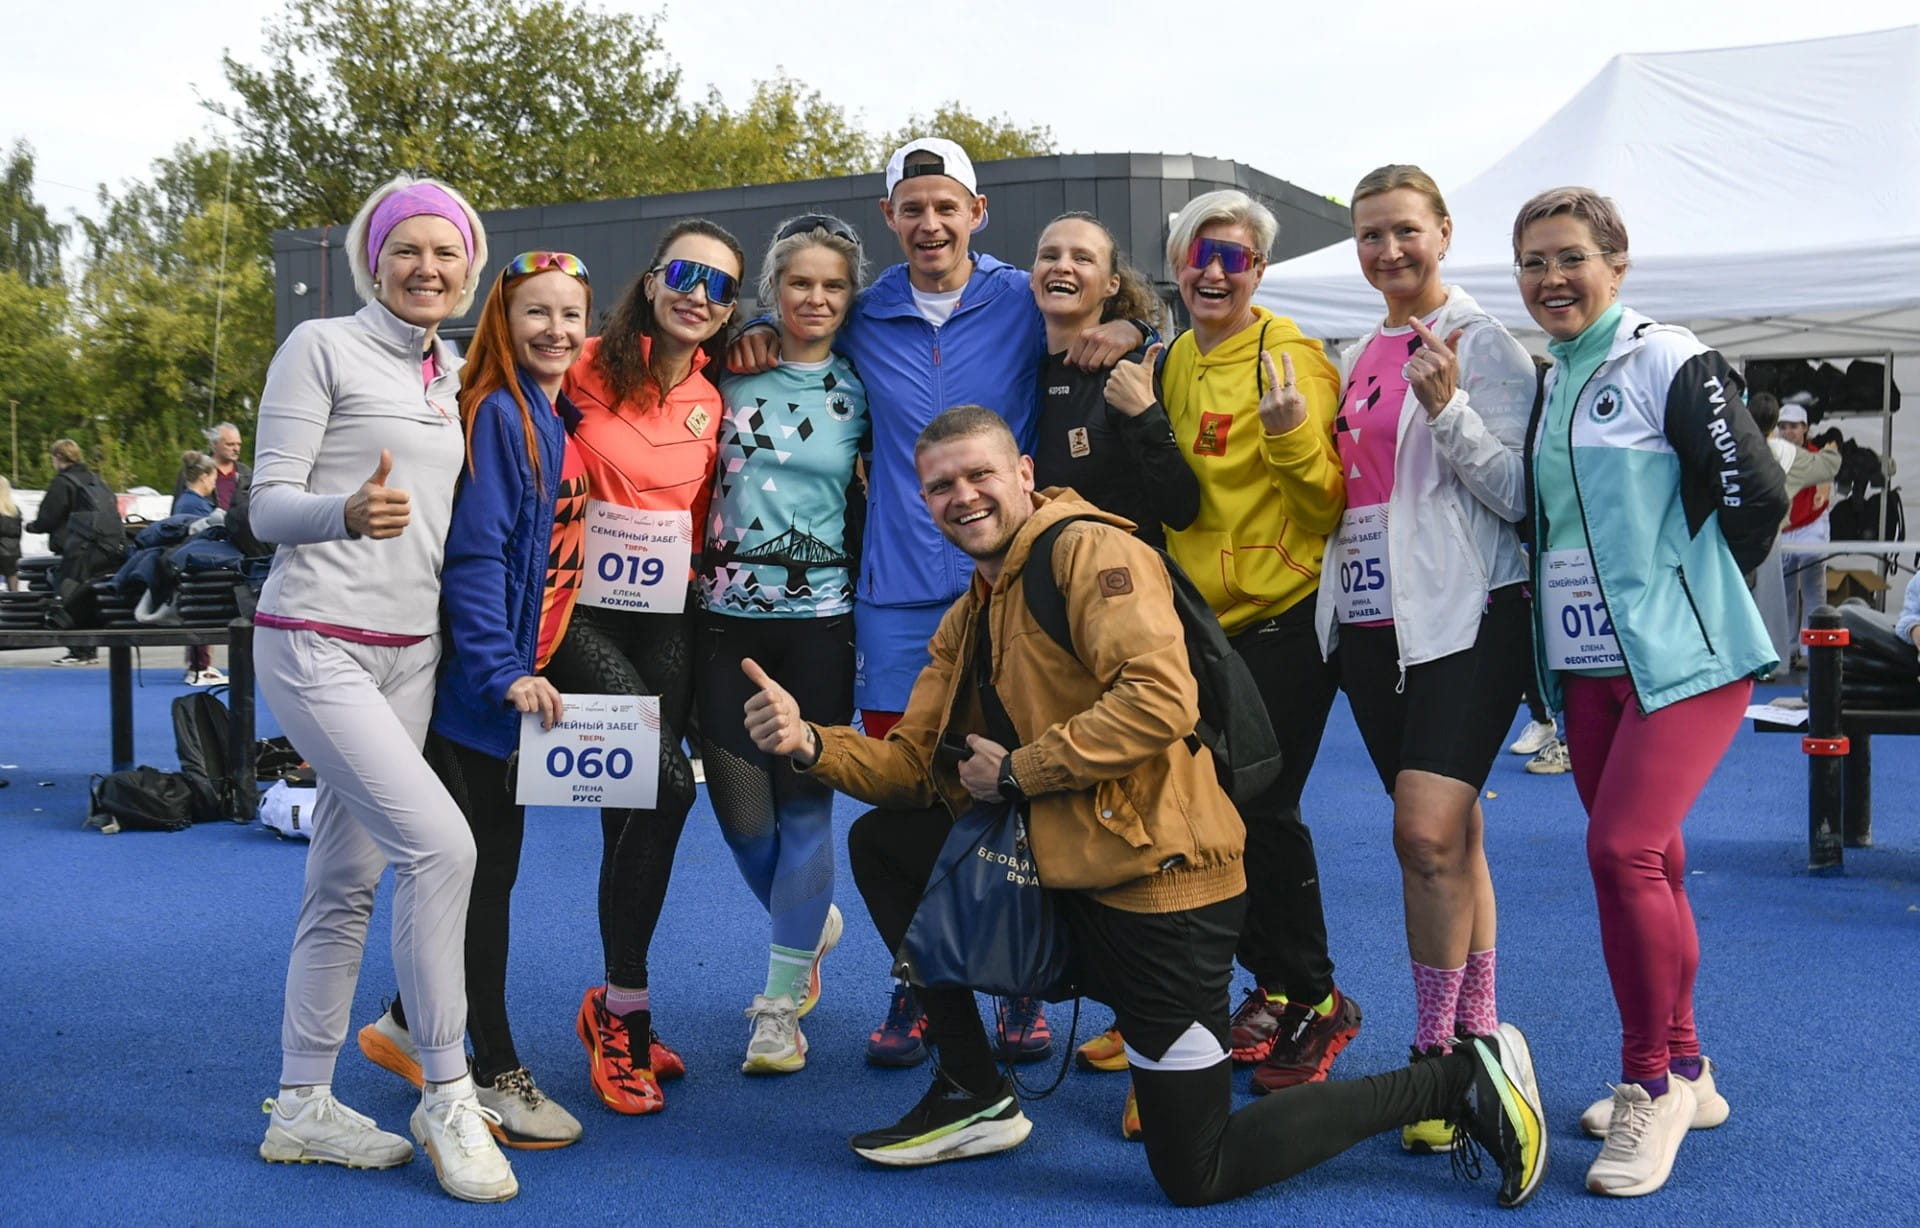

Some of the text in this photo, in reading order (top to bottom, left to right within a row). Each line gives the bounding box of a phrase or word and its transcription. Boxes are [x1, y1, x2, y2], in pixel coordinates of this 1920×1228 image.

[1720, 469, 1741, 507] LAB
[590, 525, 678, 544] СЕМЕЙНЫЙ ЗАБЕГ
[1359, 531, 1382, 543] ЗАБЕГ
[624, 543, 648, 552] ТВЕРЬ
[597, 552, 664, 586] 019
[1340, 557, 1385, 594] 025
[1548, 575, 1589, 588] СЕМЕЙНЫЙ
[612, 588, 642, 598] ЕЛЕНА
[600, 596, 650, 609] ХОХЛОВА
[1561, 601, 1616, 639] 012
[1580, 643, 1606, 653] ЕЛЕНА
[540, 720, 639, 731] СМЕЙНЫЙ ЗАБЕГ
[578, 734, 606, 742] ТВЕРЬ
[546, 746, 634, 779] 060
[572, 784, 604, 793] ЕЛЕНА
[572, 794, 602, 803] РУСС
